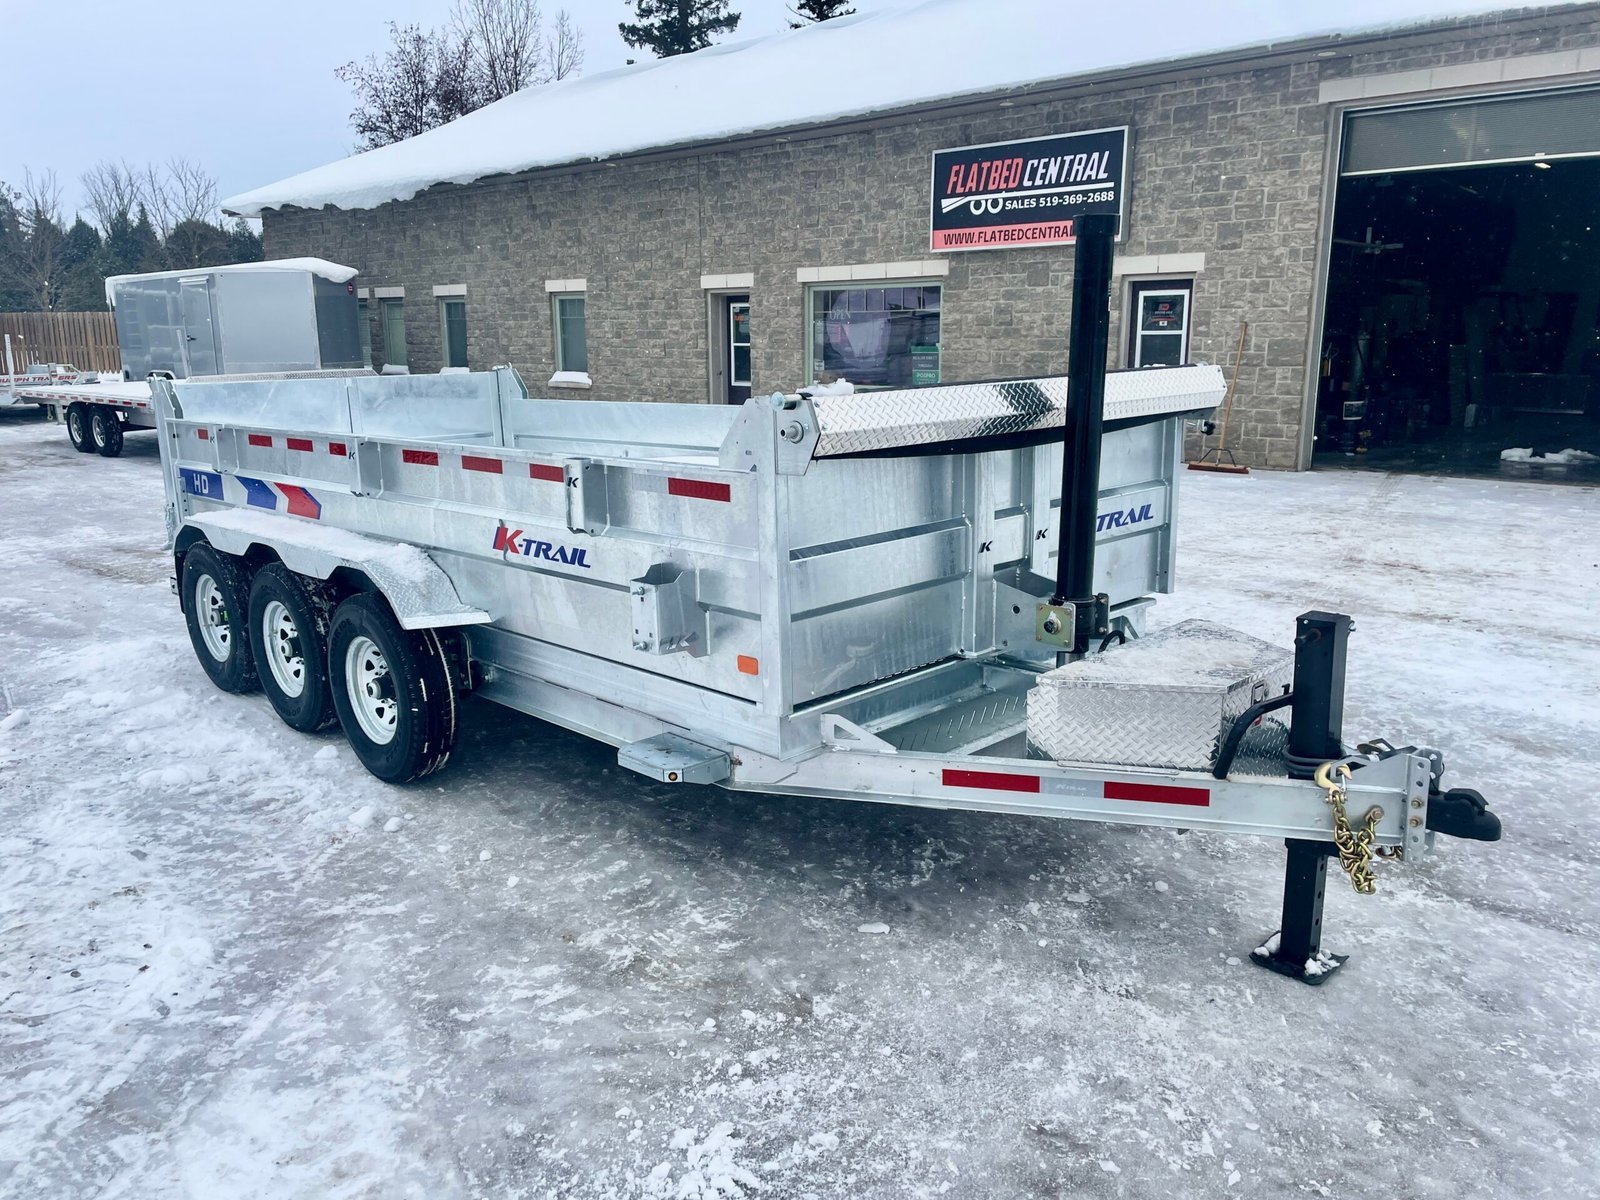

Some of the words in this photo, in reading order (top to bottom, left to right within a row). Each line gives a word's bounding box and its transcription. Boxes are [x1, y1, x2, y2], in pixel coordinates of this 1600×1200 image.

[947, 157, 1024, 195] FLATBED
[1023, 150, 1110, 187] CENTRAL
[1005, 198, 1036, 210] SALES
[1039, 190, 1115, 207] 519-369-2688
[348, 450, 356, 460] K
[193, 473, 209, 494] HD
[567, 476, 579, 488] K
[1035, 528, 1048, 541] K
[492, 526, 591, 569] K-TRAIL
[978, 540, 993, 554] K
